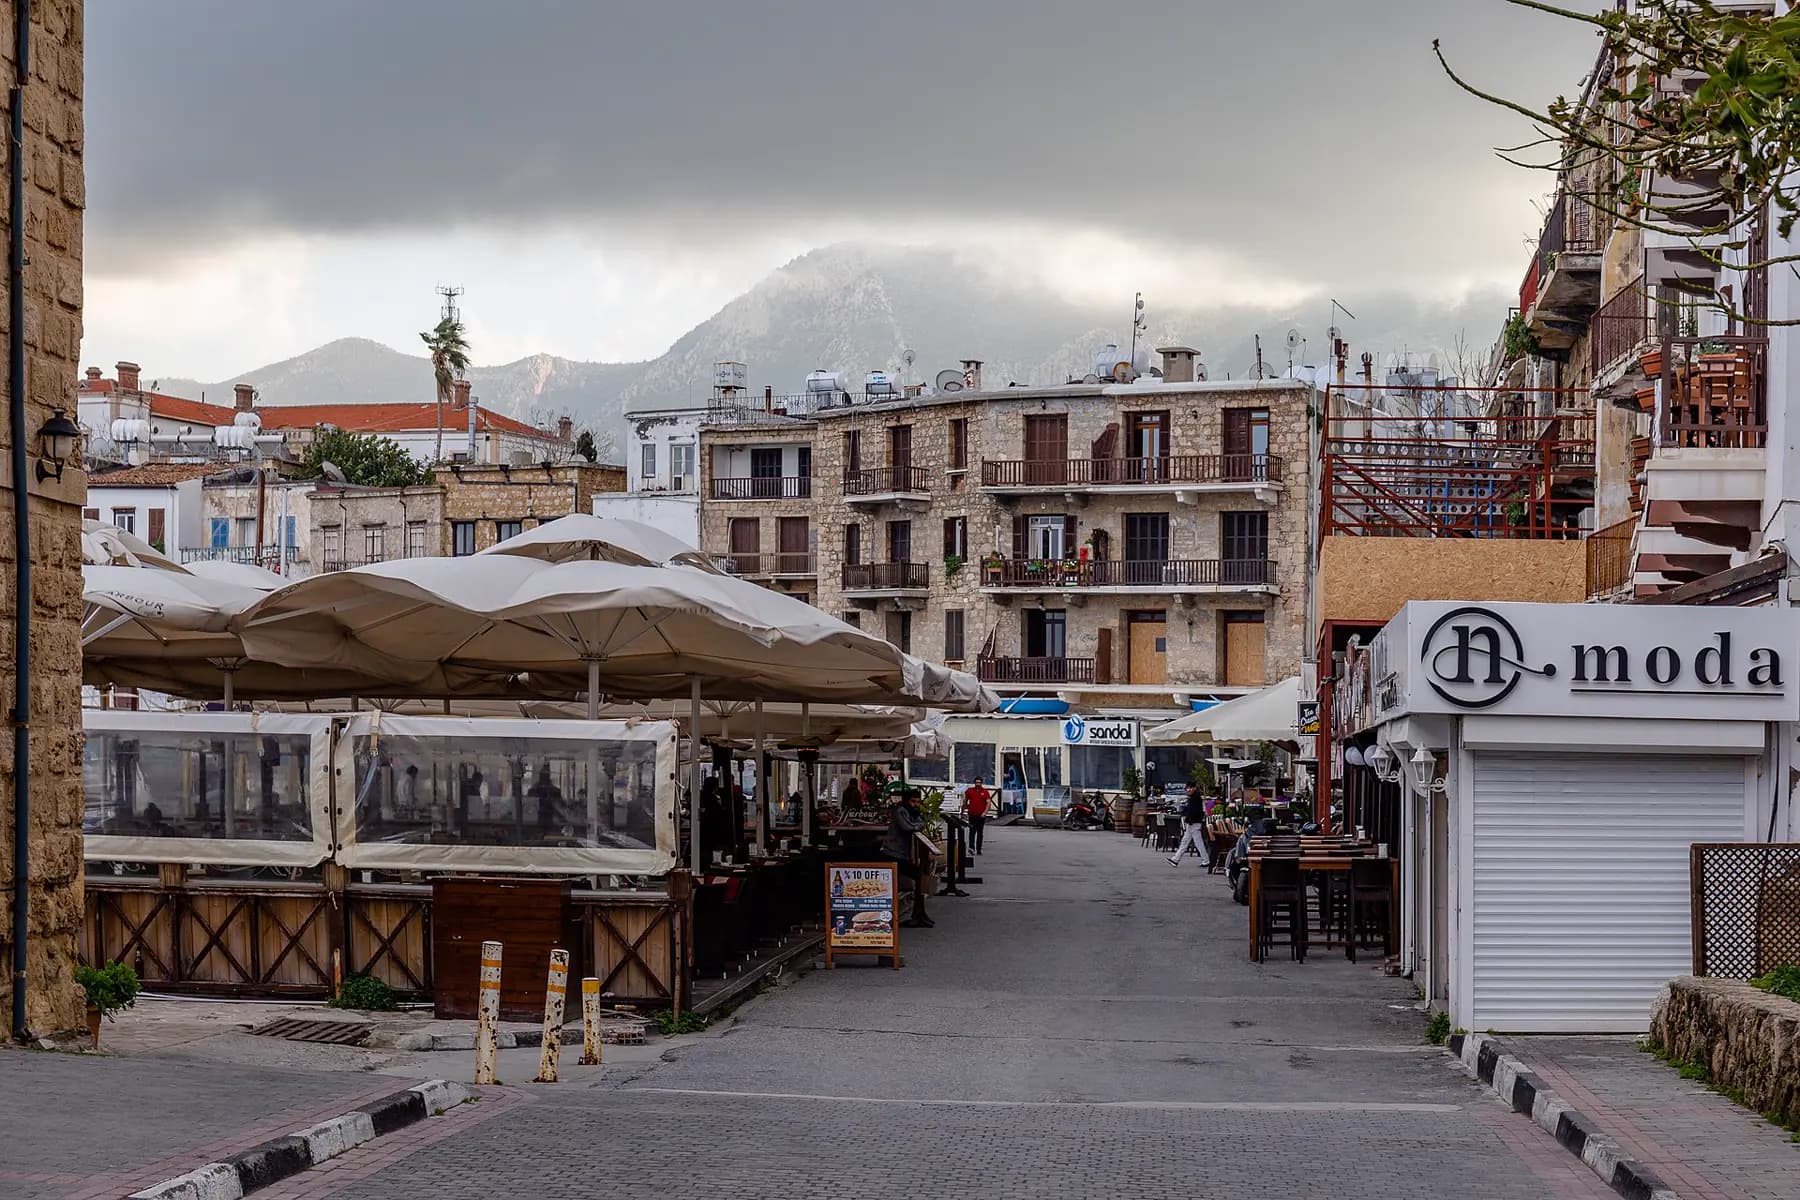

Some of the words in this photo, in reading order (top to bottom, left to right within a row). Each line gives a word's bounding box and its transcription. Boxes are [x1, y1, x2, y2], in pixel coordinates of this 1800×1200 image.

[1570, 631, 1785, 686] moda
[1089, 723, 1131, 739] sandal
[853, 871, 862, 880] 10
[864, 871, 879, 880] OFF
